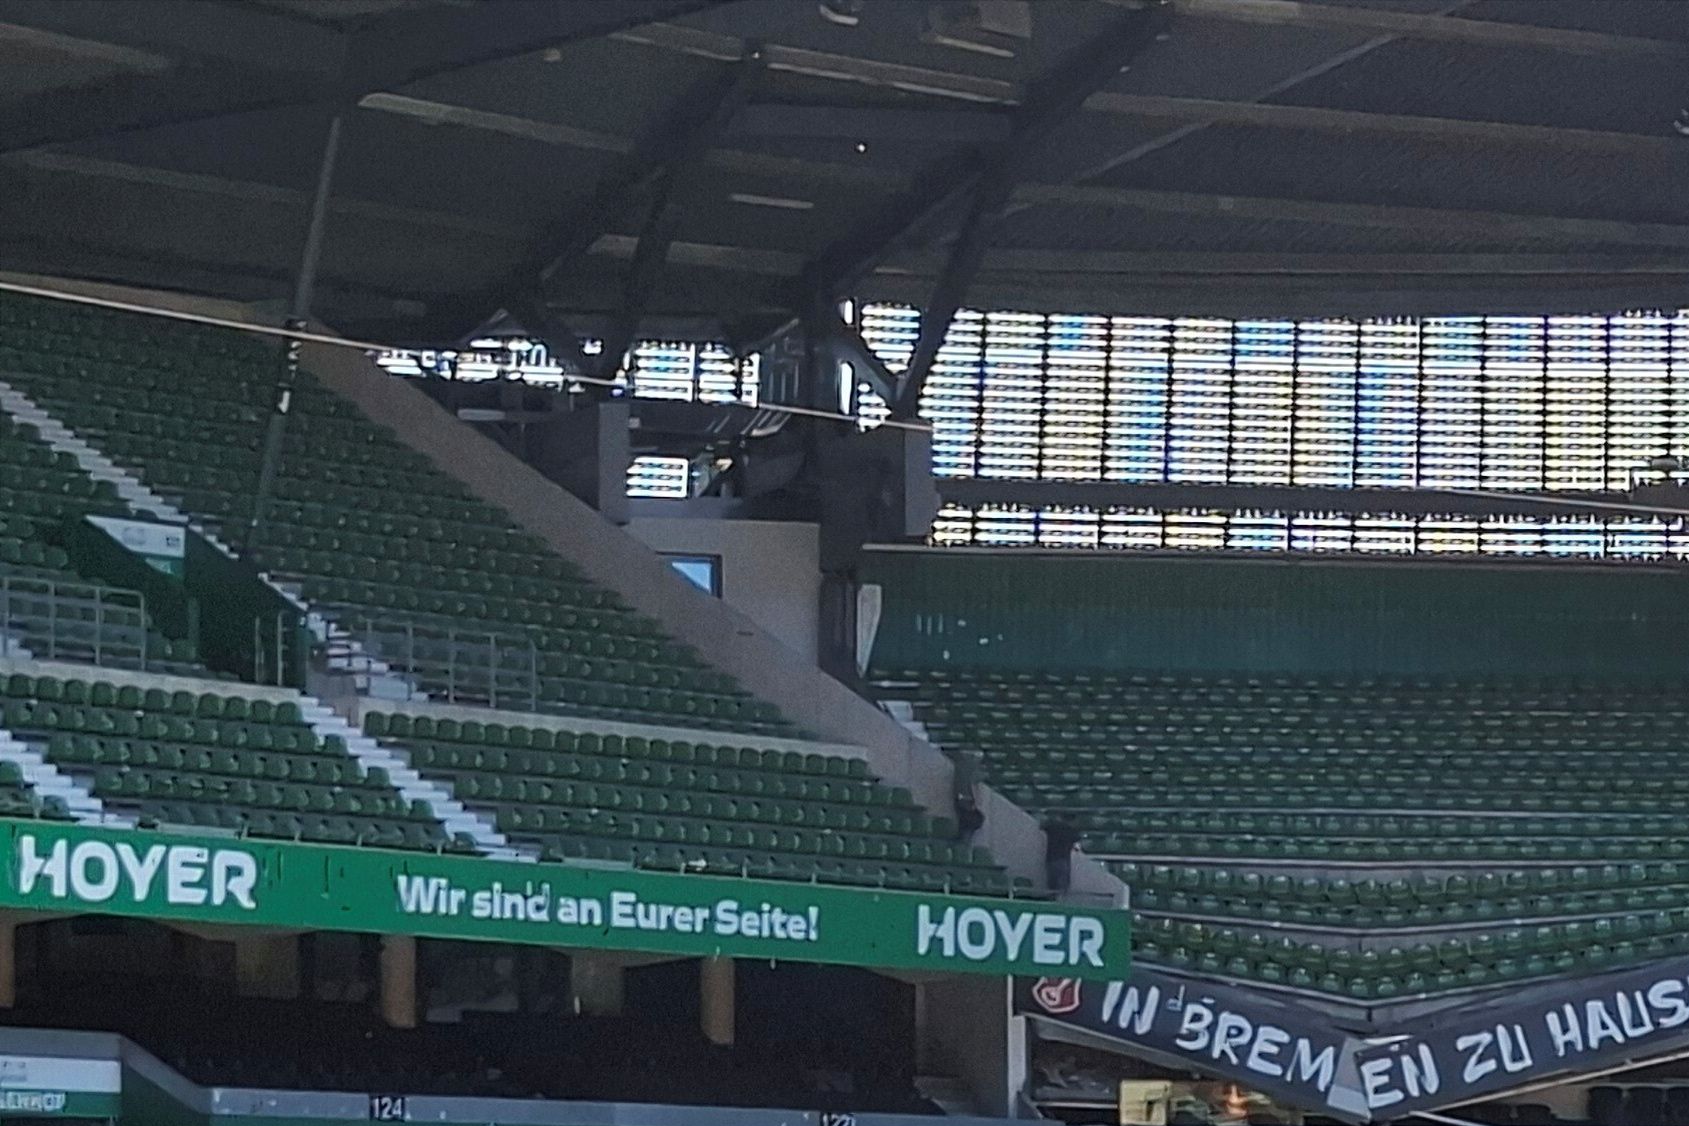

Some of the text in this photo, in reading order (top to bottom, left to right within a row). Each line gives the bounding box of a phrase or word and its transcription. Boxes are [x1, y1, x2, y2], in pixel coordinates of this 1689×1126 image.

[20, 835, 257, 910] HOYER
[397, 874, 820, 942] Wir sind an Eurer Seite!
[918, 904, 1105, 967] HOYER
[1102, 981, 1160, 1035] IN
[1456, 1024, 1532, 1084] ZU
[374, 1097, 402, 1119] 124
